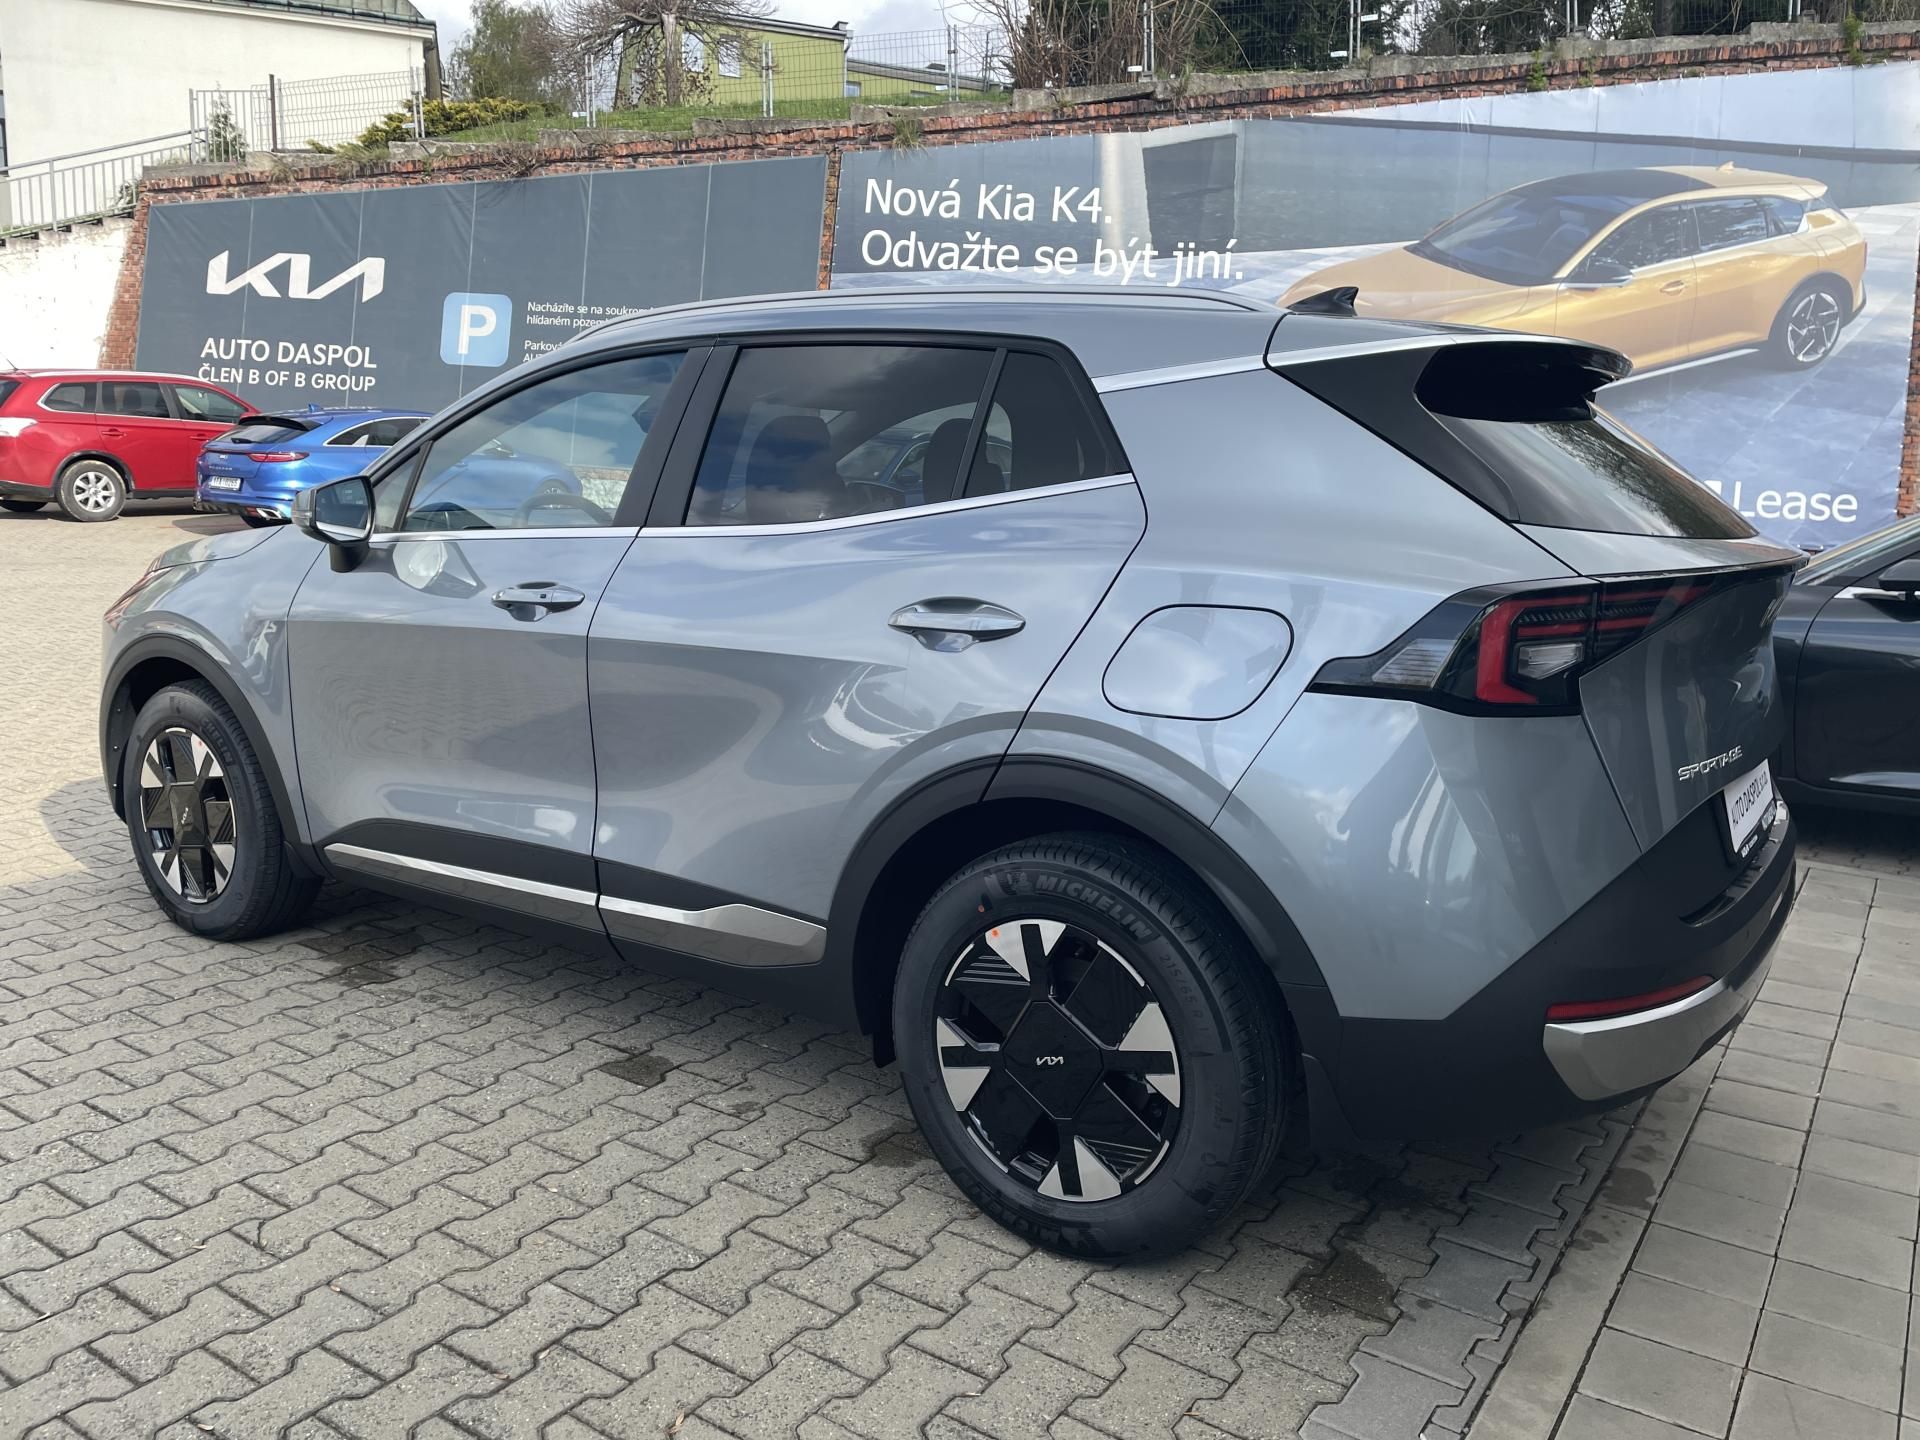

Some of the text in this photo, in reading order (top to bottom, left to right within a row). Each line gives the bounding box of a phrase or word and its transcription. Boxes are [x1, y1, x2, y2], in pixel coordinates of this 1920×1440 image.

[864, 178, 1112, 224] Nová Kia K4.
[861, 230, 1243, 288] Odvažte se být jiní.
[458, 304, 497, 354] P
[577, 305, 588, 314] se
[591, 306, 603, 314] na
[200, 337, 377, 369] AUTO DASPOL
[198, 363, 376, 392] ČLEN B OF B GROUP
[1733, 480, 1858, 523] Lease
[1678, 745, 1743, 781] SPORTAGE
[1036, 874, 1154, 940] MICHELIN
